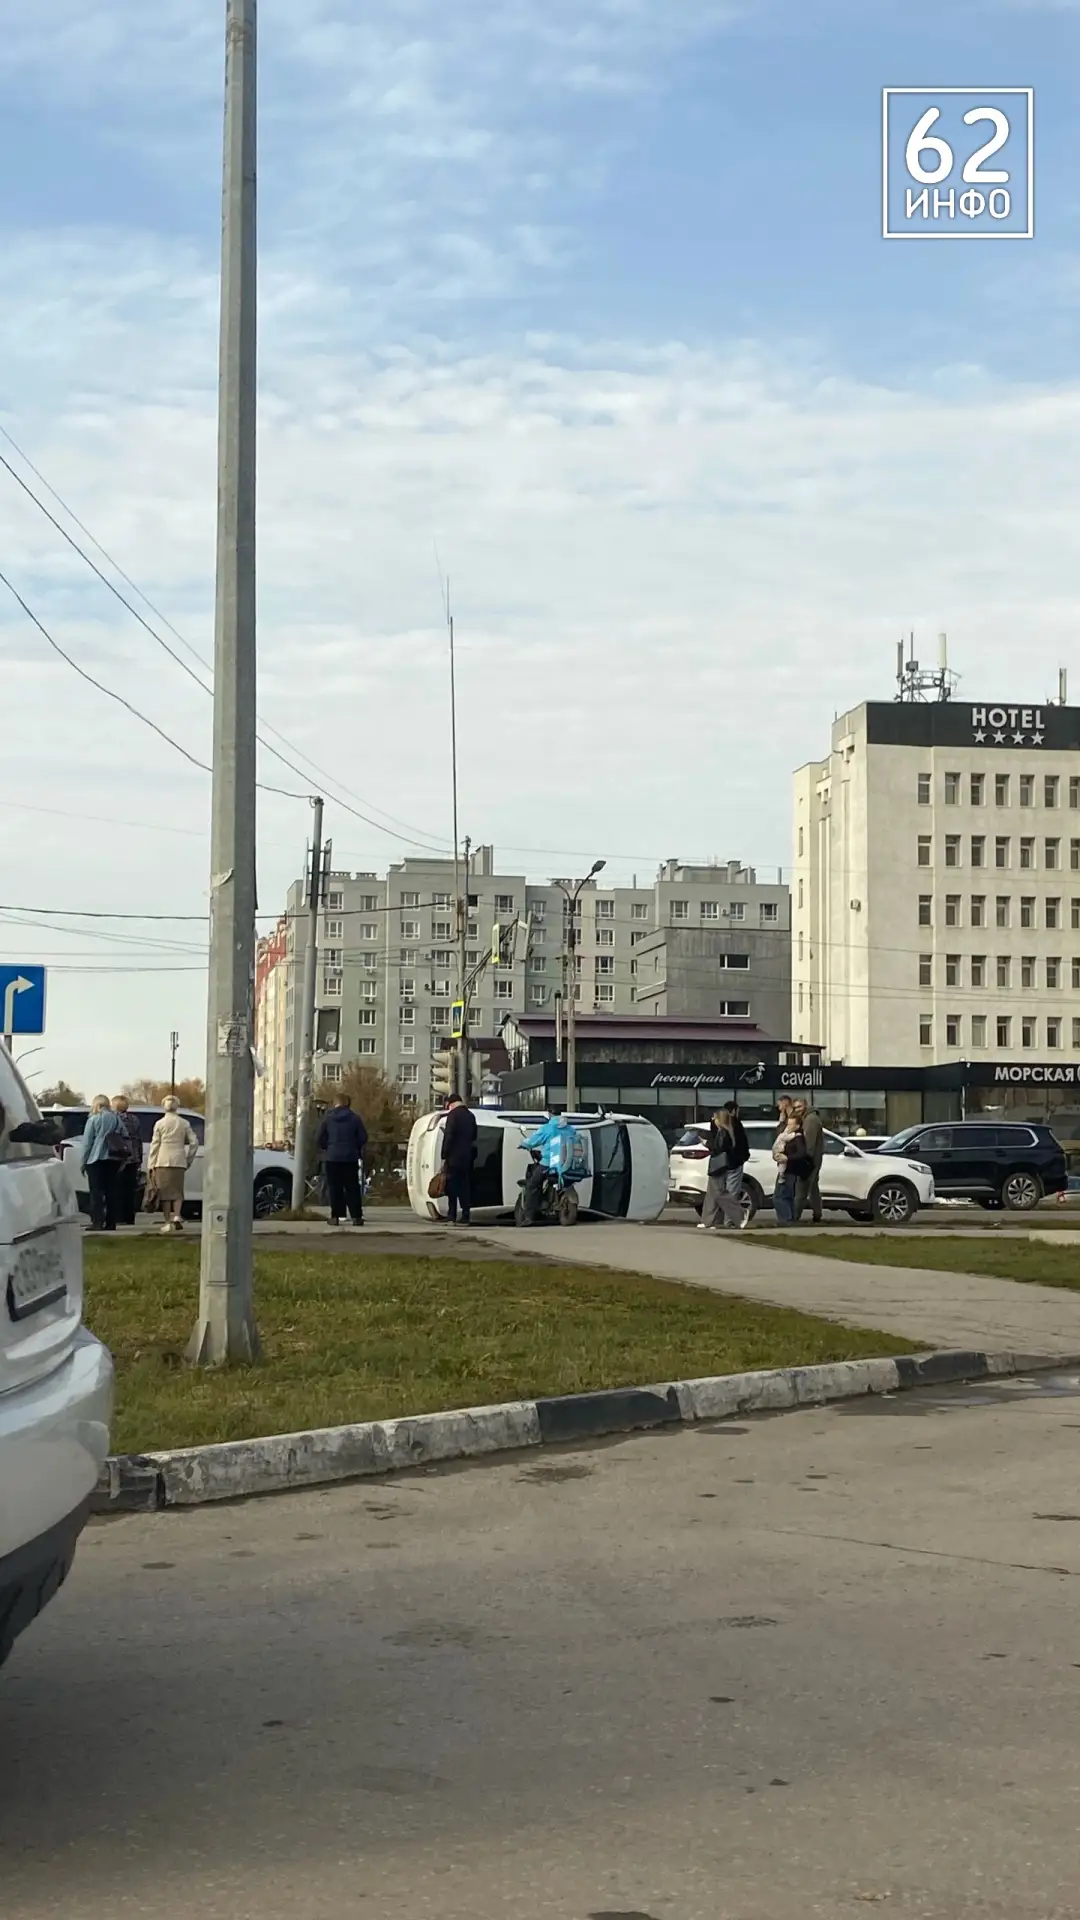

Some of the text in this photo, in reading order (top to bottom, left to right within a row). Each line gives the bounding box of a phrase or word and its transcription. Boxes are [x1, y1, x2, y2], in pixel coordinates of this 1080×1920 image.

[971, 707, 1045, 729] HOTEL
[650, 1069, 823, 1088] ресторан cavalli
[994, 1066, 1075, 1082] МОРСКАЯ
